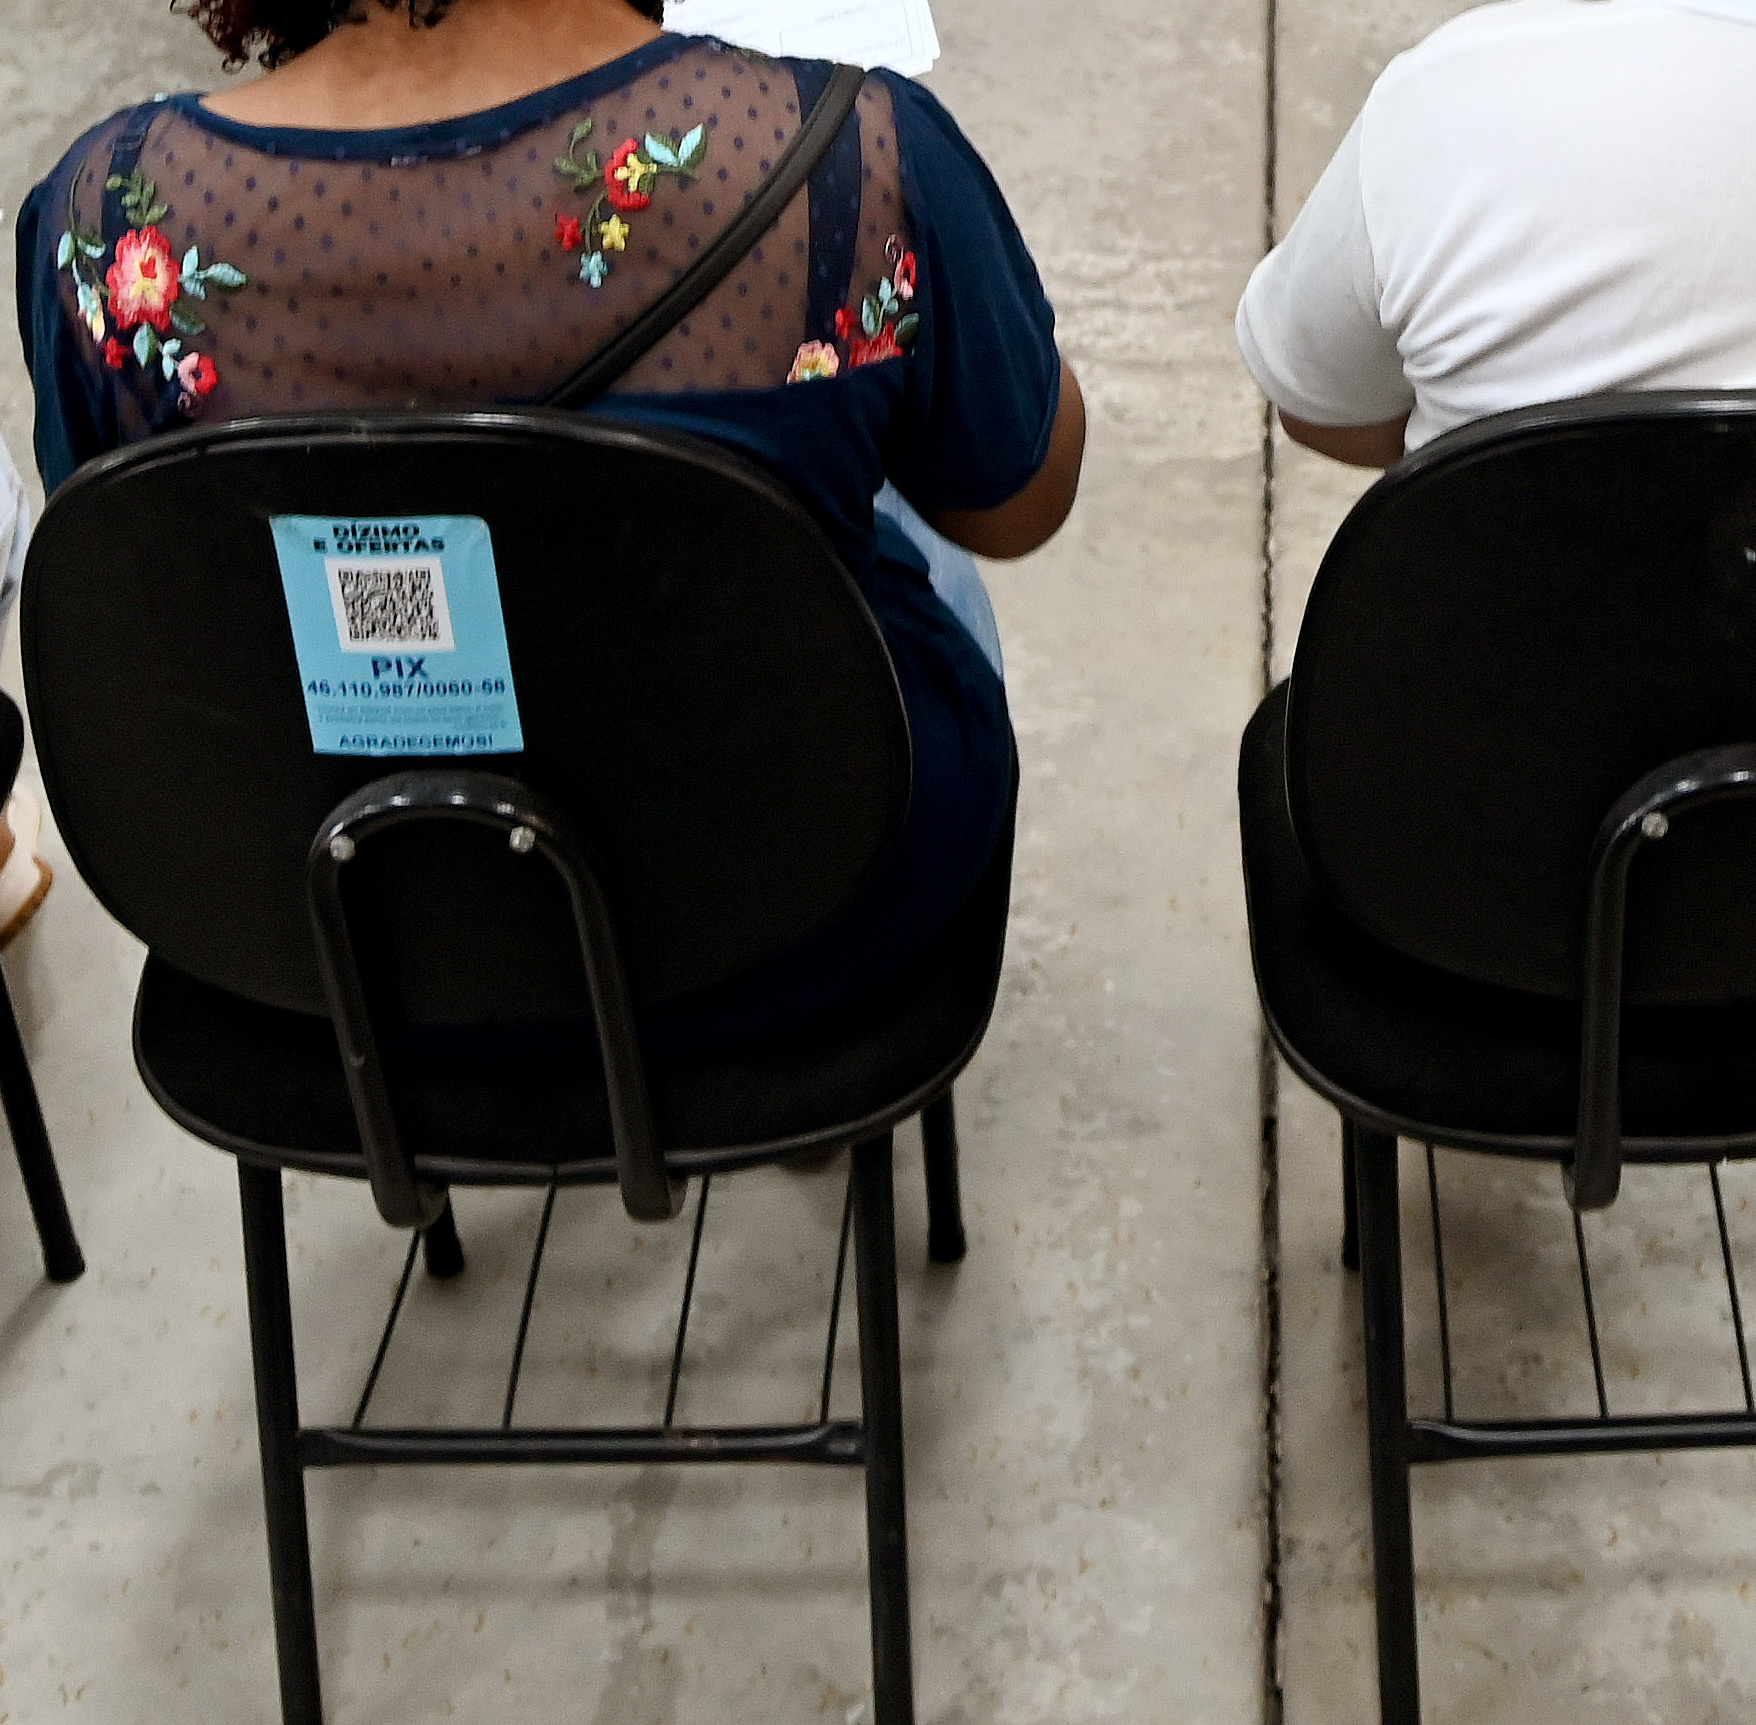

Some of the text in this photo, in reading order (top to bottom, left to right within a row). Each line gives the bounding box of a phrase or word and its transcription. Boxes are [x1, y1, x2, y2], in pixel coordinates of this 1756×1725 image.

[331, 522, 420, 539] DÍZIMO
[313, 537, 445, 555] E OFERTAS
[370, 654, 429, 679] PIX
[338, 733, 494, 749] AGRADECEMOS!
